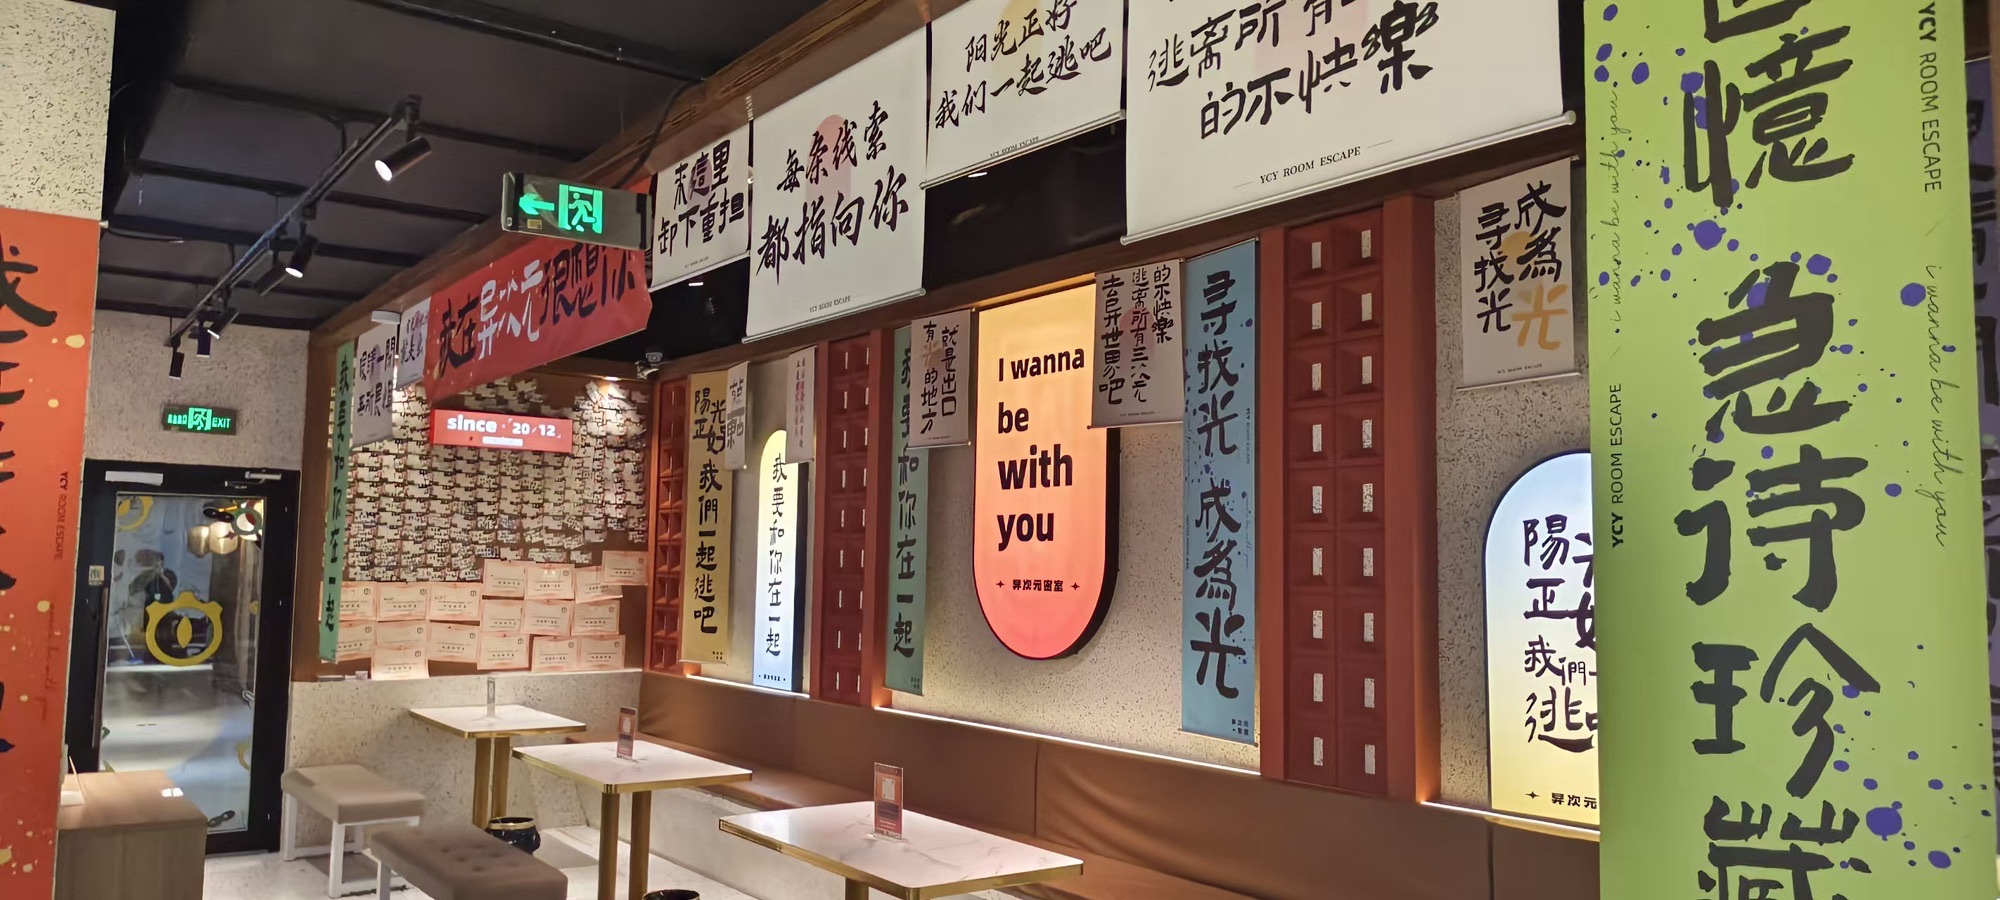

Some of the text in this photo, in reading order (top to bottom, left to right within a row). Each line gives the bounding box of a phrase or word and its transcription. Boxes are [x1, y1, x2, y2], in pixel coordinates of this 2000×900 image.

[965, 0, 1077, 72] 阳光正好
[1148, 0, 1355, 92] 逃离所有
[935, 27, 1111, 129] 我们一起逃吧
[1918, 1, 1942, 193] YCY ROOM ESCAPE
[1610, 91, 1631, 135] you
[1260, 146, 1361, 184] YCY ROOM ESCAPE
[756, 165, 909, 286] 都指向你
[1600, 199, 1620, 227] be
[1612, 232, 1621, 305] wanna
[1926, 285, 1941, 373] wanna
[941, 325, 960, 416] 就是出口
[999, 347, 1085, 382] I wanna
[212, 417, 231, 429] EXIT
[447, 414, 498, 433] since
[998, 402, 1029, 434] be
[1930, 379, 1960, 414] be
[997, 444, 1073, 491] with
[1609, 383, 1624, 548] YCY ROOM ESCAPE
[1932, 419, 1963, 485] with
[997, 512, 1055, 552] you
[1915, 488, 1946, 547] you
